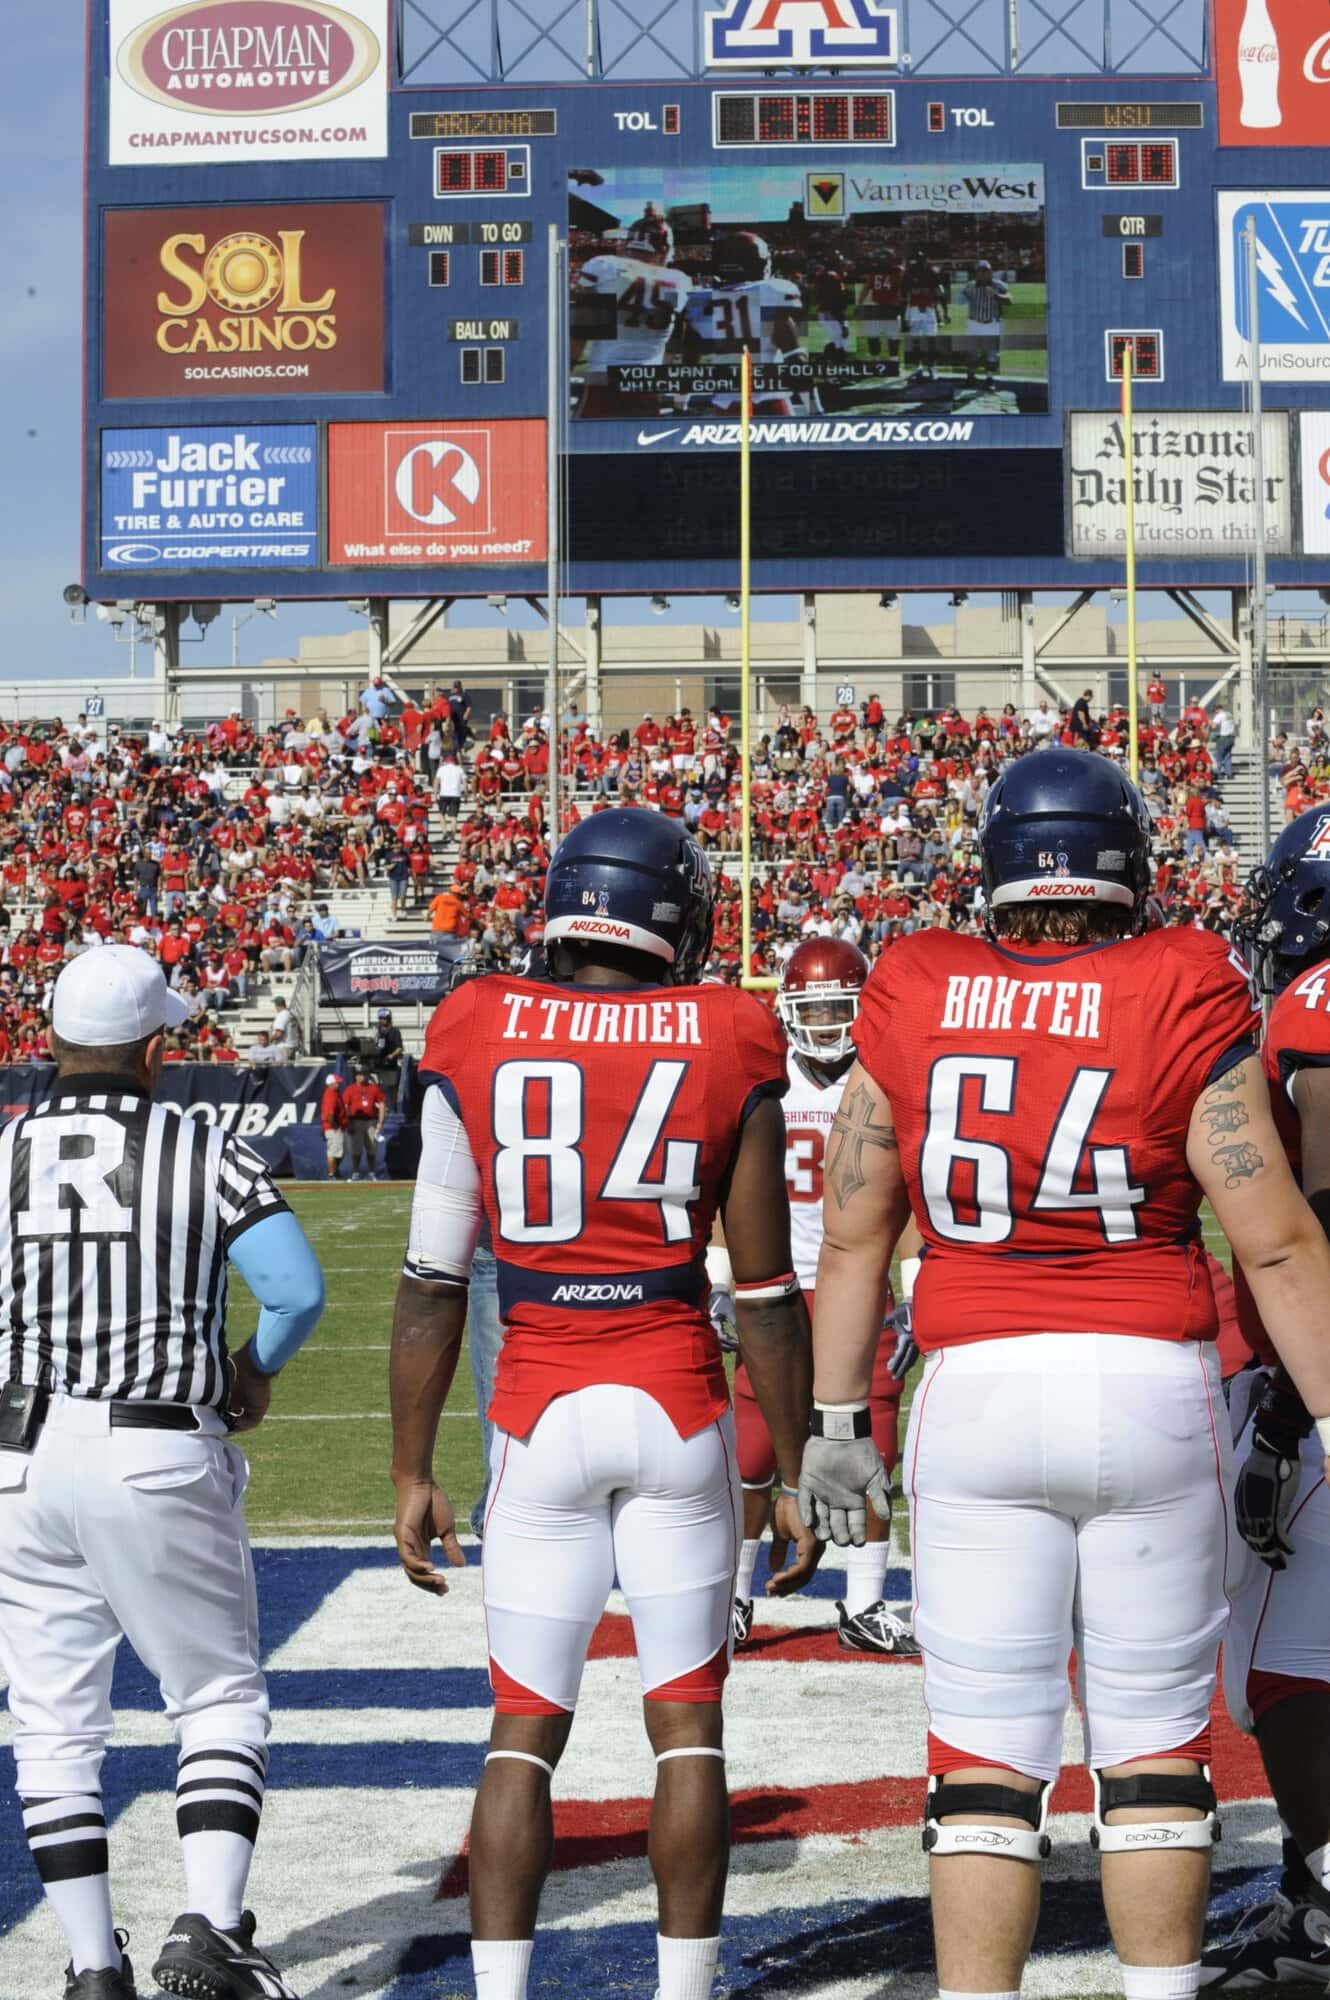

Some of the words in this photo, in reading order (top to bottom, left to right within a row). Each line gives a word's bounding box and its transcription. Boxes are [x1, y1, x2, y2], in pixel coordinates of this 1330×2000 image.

[162, 23, 333, 72] CHAPMAN
[167, 70, 329, 90] AUTOMOTIVE
[434, 111, 532, 136] ARIZONA
[614, 112, 657, 131] TOL
[951, 108, 995, 127] TOL
[1103, 105, 1151, 126] WSU
[128, 127, 368, 148] CHAPMANTUCSON.COM
[423, 225, 454, 243] DWN
[481, 223, 499, 242] TO
[502, 223, 522, 242] GO
[1119, 217, 1145, 235] QTR
[157, 230, 336, 316] SOL
[156, 316, 337, 354] CASINOS
[456, 321, 486, 340] BALL
[490, 321, 509, 339] ON
[1235, 353, 1248, 368] A
[184, 365, 309, 380] SOLCASINOS.COM
[619, 366, 656, 379] YOU
[667, 366, 714, 379] WANT
[730, 365, 765, 377] TE
[619, 381, 680, 393] WHICH
[692, 380, 735, 392] GOAL
[679, 421, 975, 446] ARIZONAWILDCATS.COM
[156, 434, 261, 473] Jack
[131, 471, 286, 510] Furrier
[1070, 467, 1184, 515] Daily
[114, 514, 161, 531] TIRE
[166, 514, 182, 529] &
[187, 512, 244, 529] AUTO
[250, 511, 304, 528] CARE
[1076, 523, 1107, 543] It's
[1135, 522, 1214, 542] Tucson
[344, 543, 385, 557] What
[389, 543, 421, 556] else
[426, 542, 446, 556] do
[450, 544, 479, 558] you
[482, 540, 531, 555] need?
[838, 687, 854, 703] 28
[88, 700, 101, 715] 27
[1038, 852, 1055, 868] 64
[581, 891, 596, 906] 84
[1027, 884, 1096, 897] ARIZONA
[568, 919, 631, 940] ARIZONA
[350, 956, 400, 966] AMERICAN
[402, 955, 439, 965] FAMILY
[940, 975, 1102, 1039] BAXTER
[491, 1058, 704, 1244] 84
[919, 1053, 1147, 1245] 64
[16, 1114, 133, 1236] R
[786, 1129, 824, 1203] 3
[552, 1284, 644, 1302] ARIZONA
